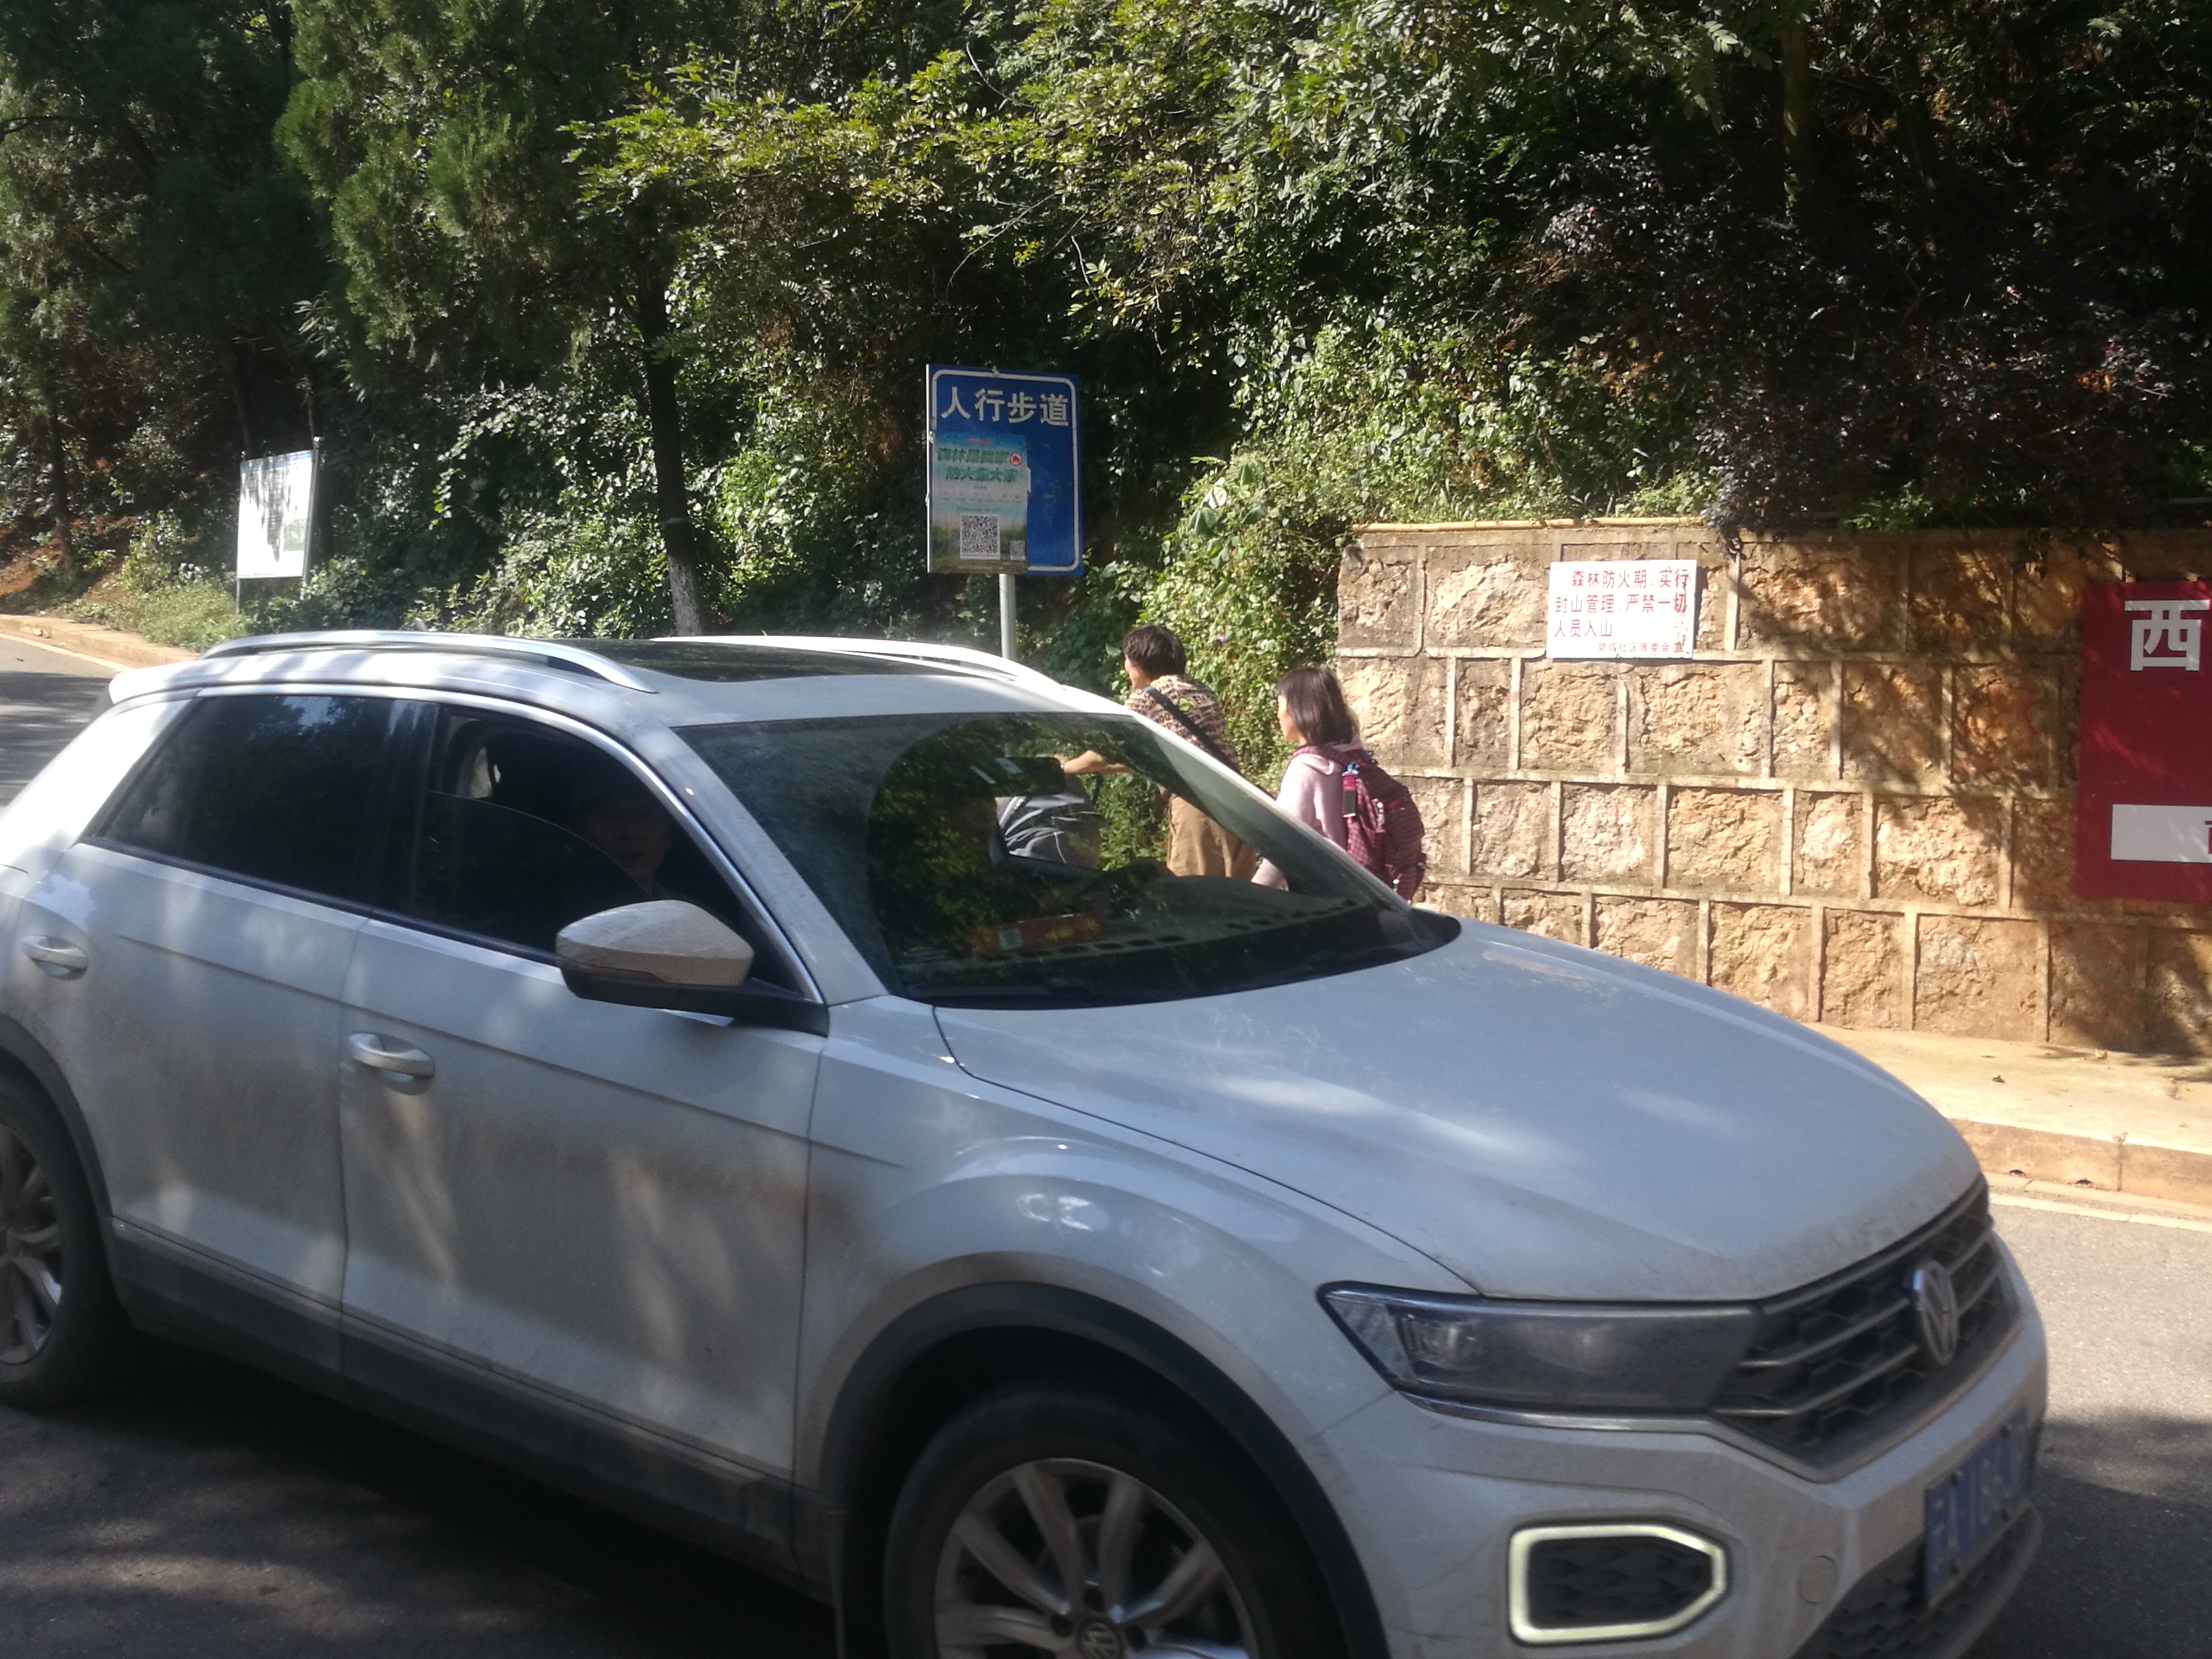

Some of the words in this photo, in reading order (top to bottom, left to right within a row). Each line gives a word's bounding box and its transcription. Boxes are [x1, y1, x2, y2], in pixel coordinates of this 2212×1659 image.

[941, 386, 1069, 426] 人行步道
[1554, 619, 1612, 637] 人员入山
[2124, 599, 2210, 671] 西
